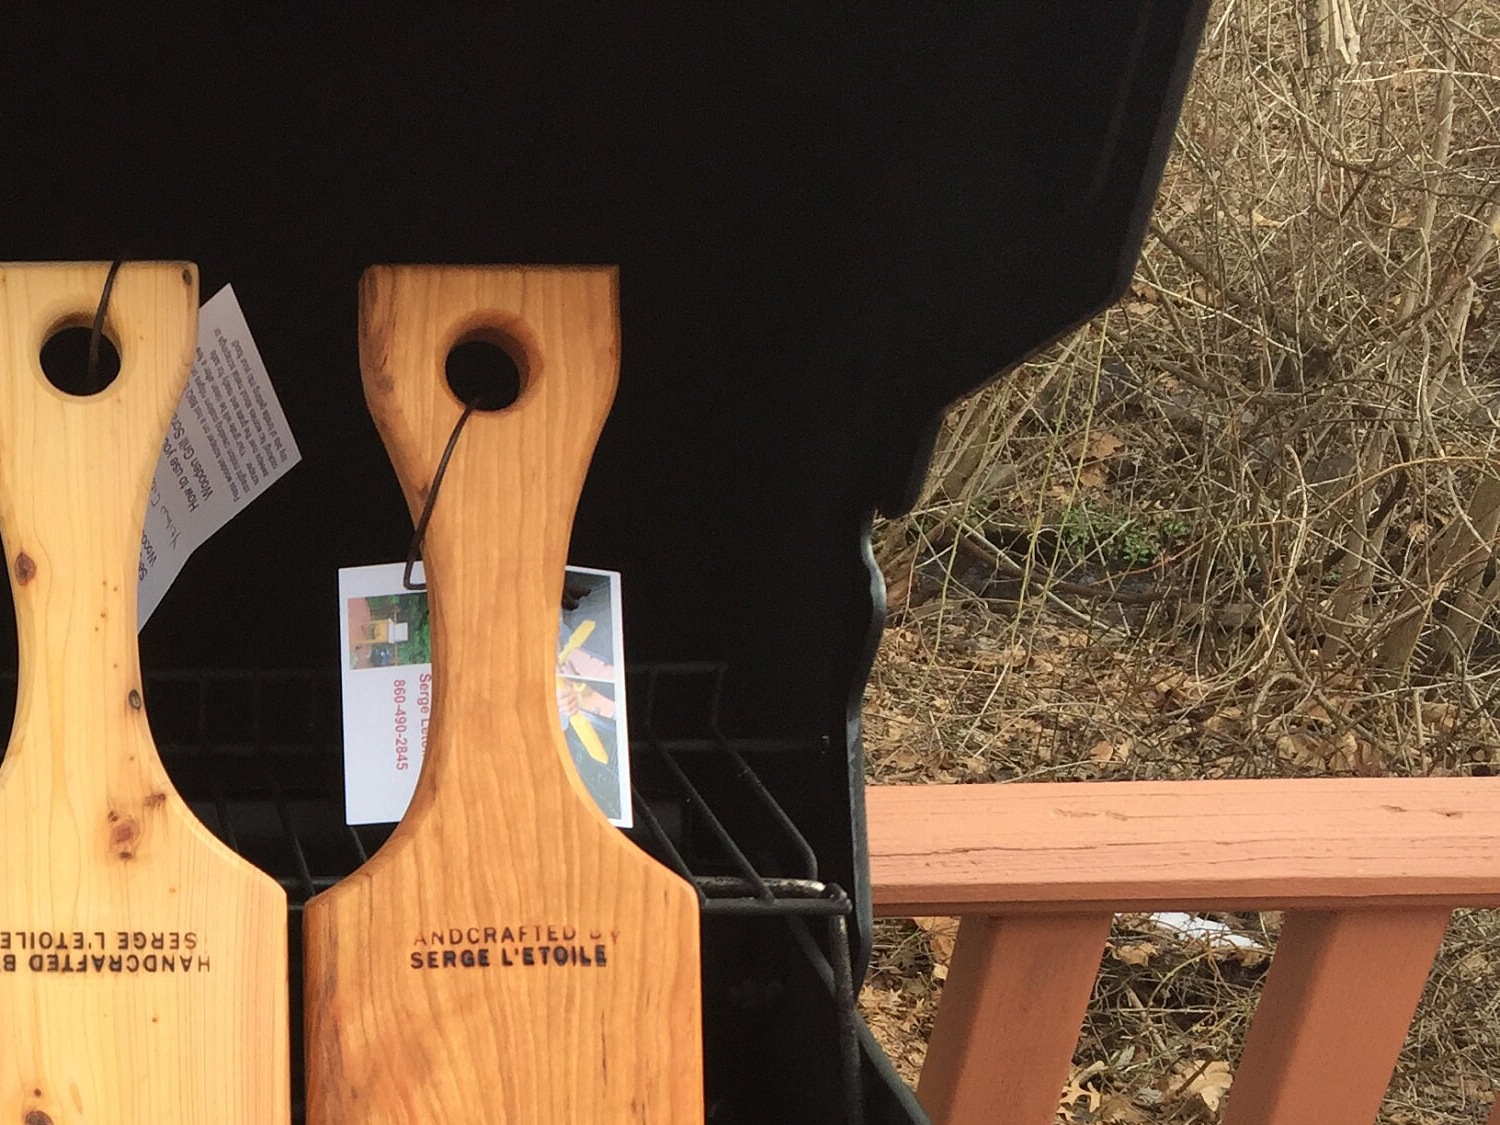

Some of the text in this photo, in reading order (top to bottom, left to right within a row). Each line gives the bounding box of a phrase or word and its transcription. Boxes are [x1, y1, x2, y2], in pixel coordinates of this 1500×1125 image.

[162, 436, 199, 512] How to use you
[170, 412, 213, 500] Wooden Grill Scra
[418, 673, 432, 714] Serge
[393, 679, 409, 771] 860-490-2845
[0, 931, 198, 950] SERGE L'ETOILE
[410, 944, 607, 969] SERGE L'ETOILE
[28, 954, 211, 972] HANDCRAFTED
